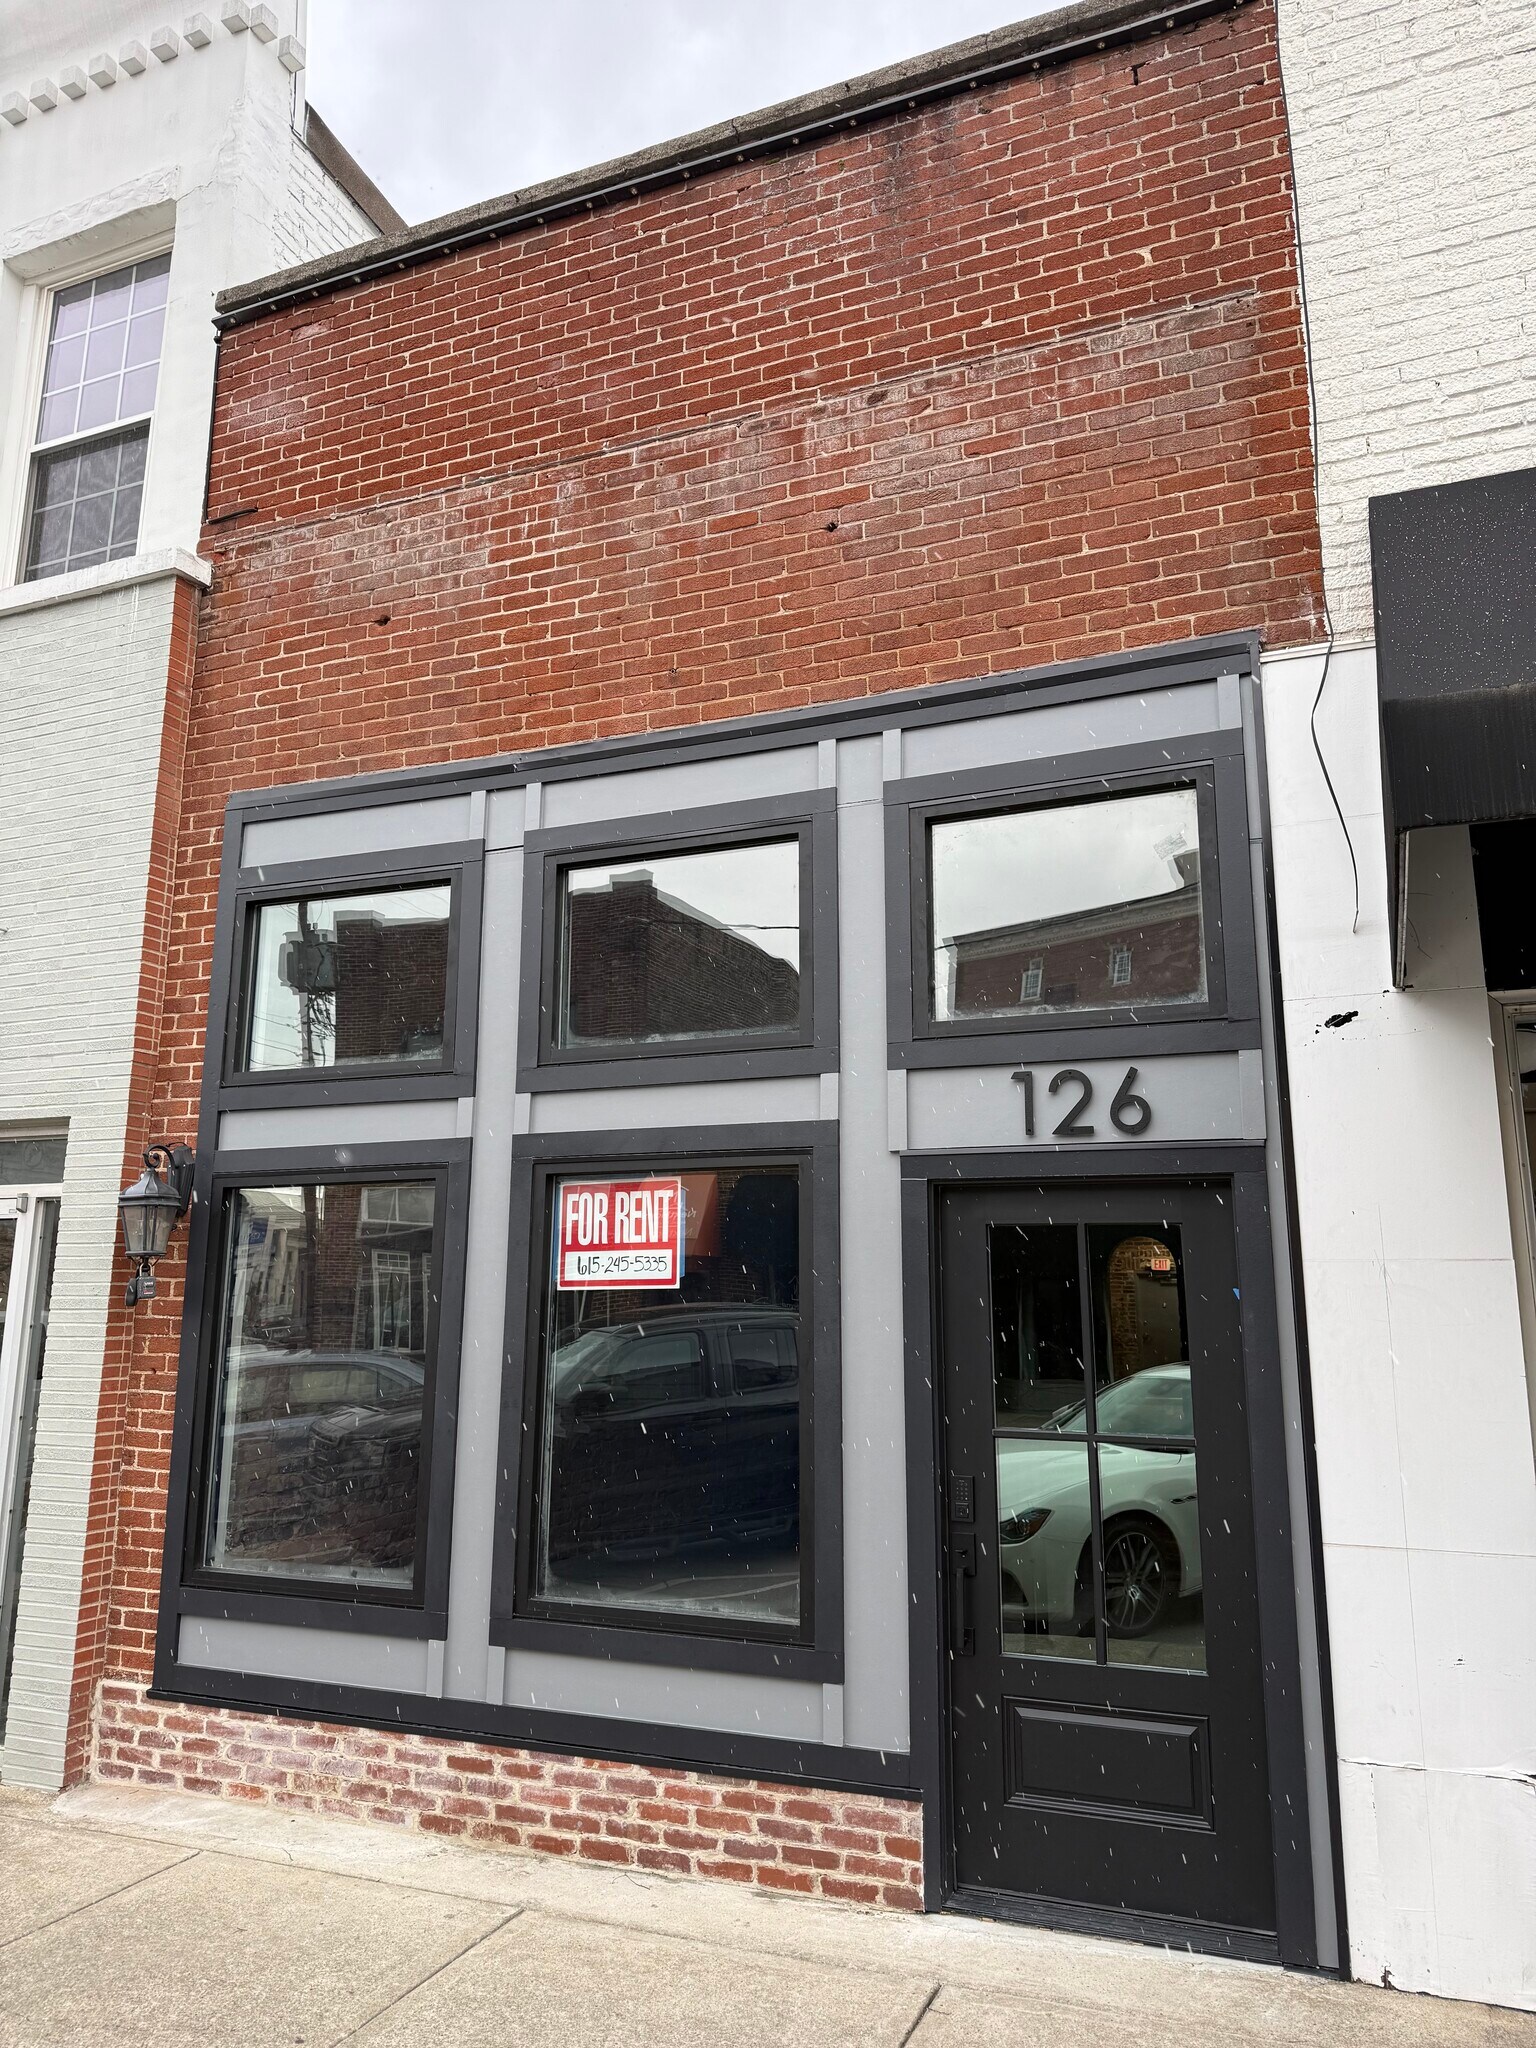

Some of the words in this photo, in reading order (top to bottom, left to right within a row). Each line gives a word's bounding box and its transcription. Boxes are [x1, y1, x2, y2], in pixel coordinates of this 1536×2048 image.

[1010, 1066, 1152, 1136] 126
[565, 1192, 609, 1246] FOR
[614, 1189, 674, 1244] RENT
[577, 1255, 668, 1275] 615-245-5335
[1154, 1259, 1168, 1270] EXIT
